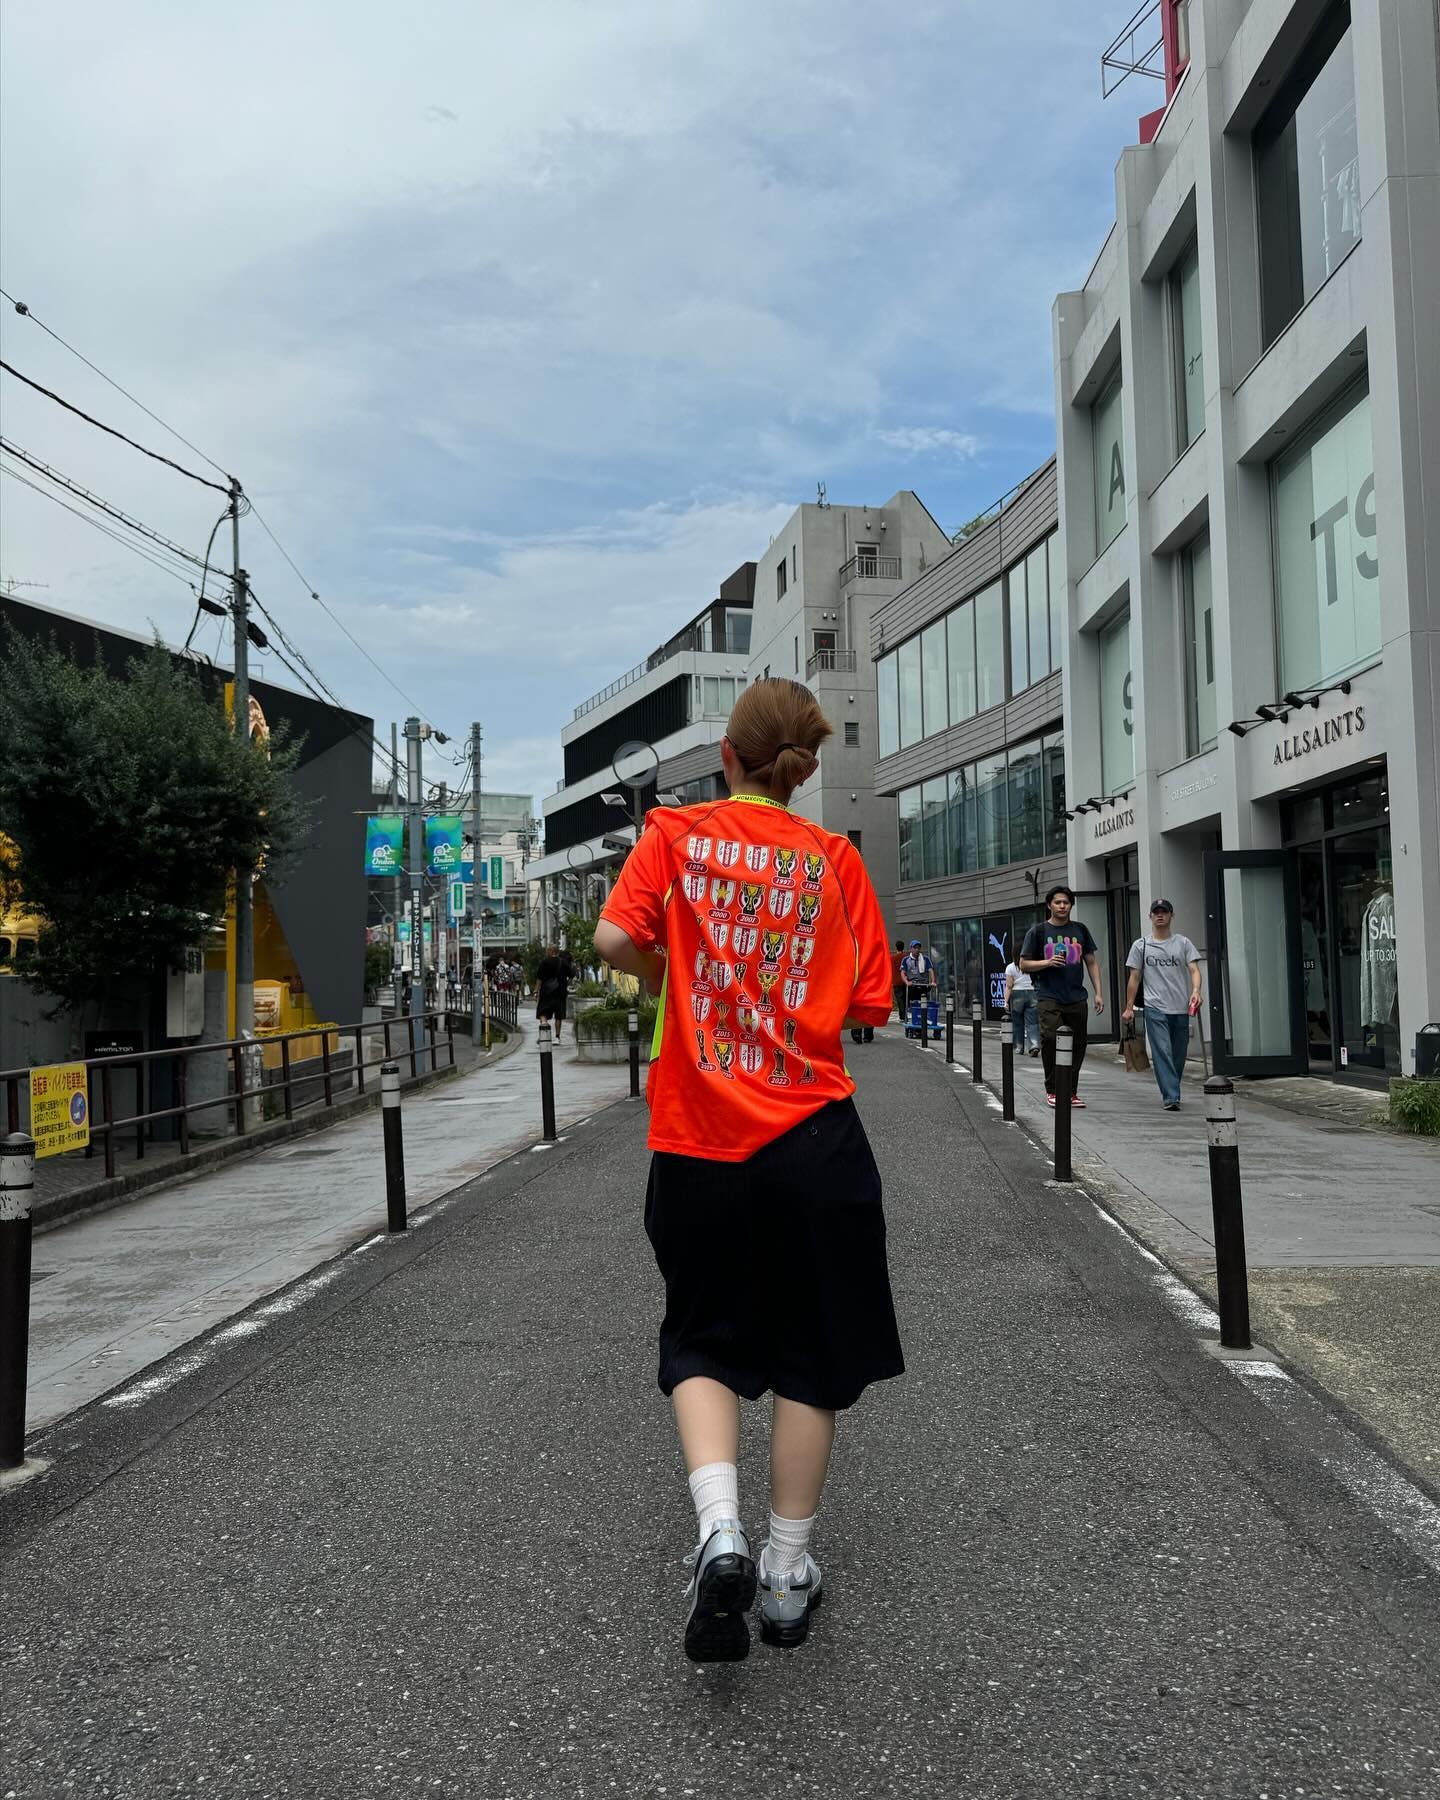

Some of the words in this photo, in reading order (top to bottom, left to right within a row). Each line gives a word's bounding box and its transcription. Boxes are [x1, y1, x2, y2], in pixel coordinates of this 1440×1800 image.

[1108, 440, 1126, 512] A
[1273, 706, 1365, 766] ALLSAINTS
[1094, 809, 1134, 839] ALLSAINTS
[710, 911, 728, 919] 2000
[740, 915, 756, 923] 2001
[1369, 916, 1396, 940] SAL
[1376, 949, 1384, 961] TO
[1386, 948, 1396, 961] 30
[991, 998, 1006, 1008] STREE
[715, 1030, 731, 1038] 2015
